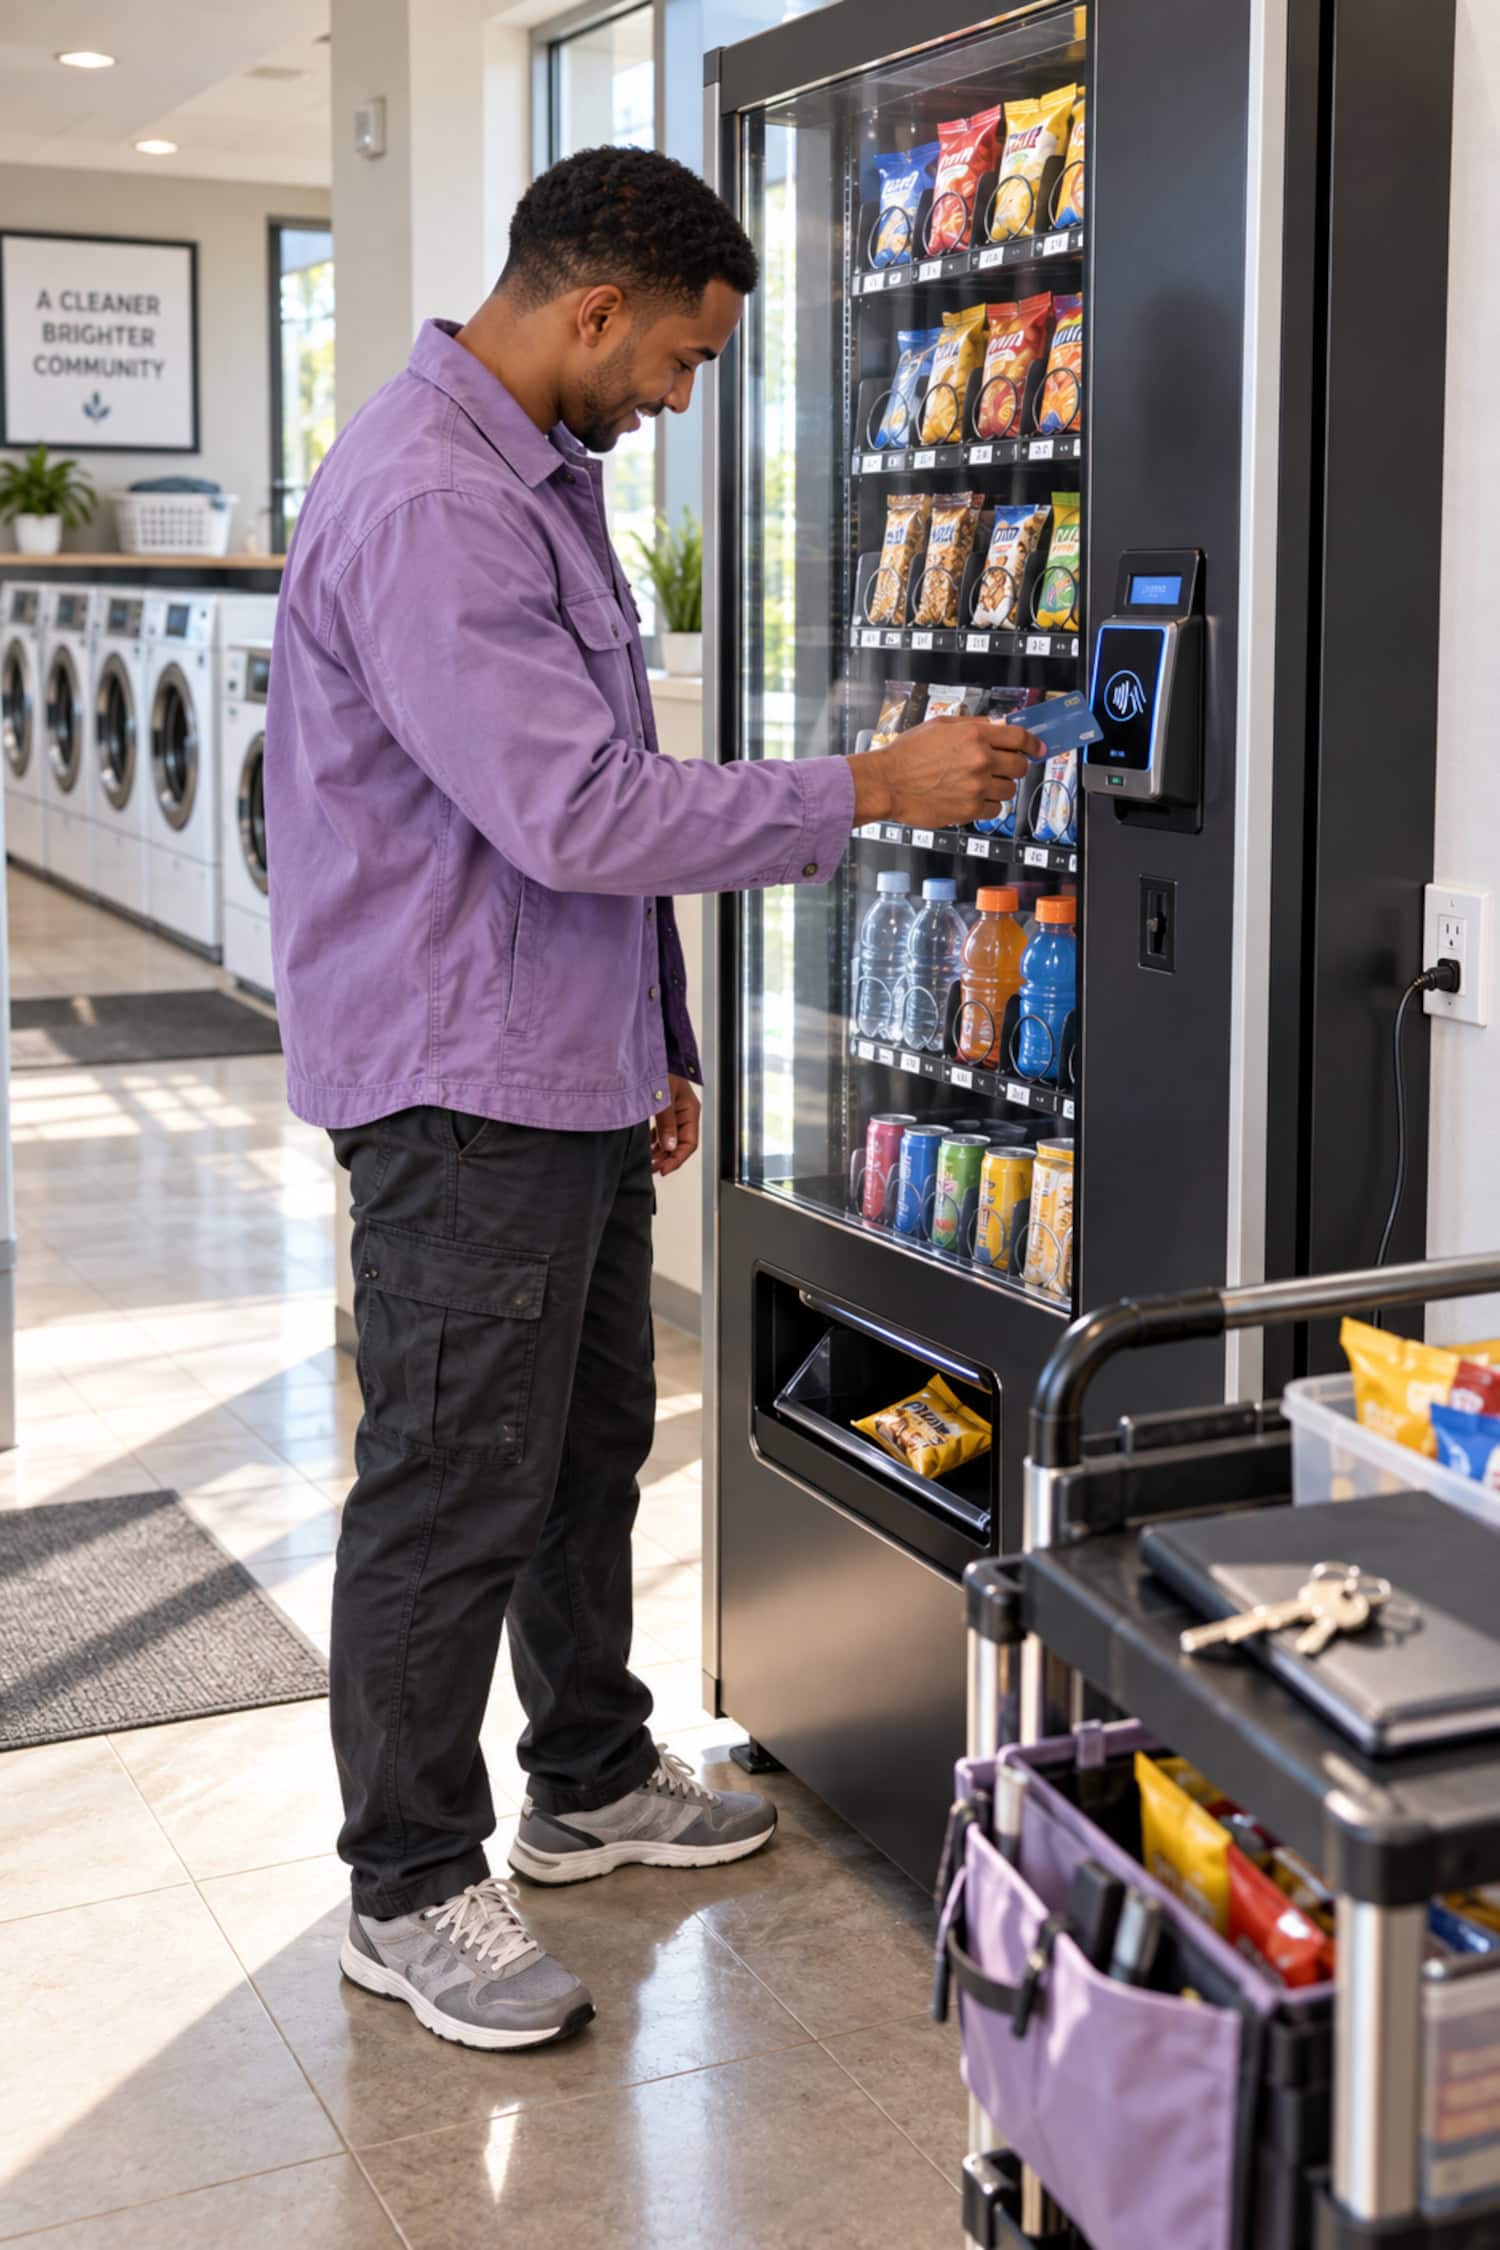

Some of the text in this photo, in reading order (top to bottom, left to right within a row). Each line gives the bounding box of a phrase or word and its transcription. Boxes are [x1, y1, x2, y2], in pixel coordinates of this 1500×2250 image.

[36, 289, 161, 316] A CLEANER
[42, 322, 155, 348] BRIGHTER
[33, 354, 165, 379] COMMUNITY
